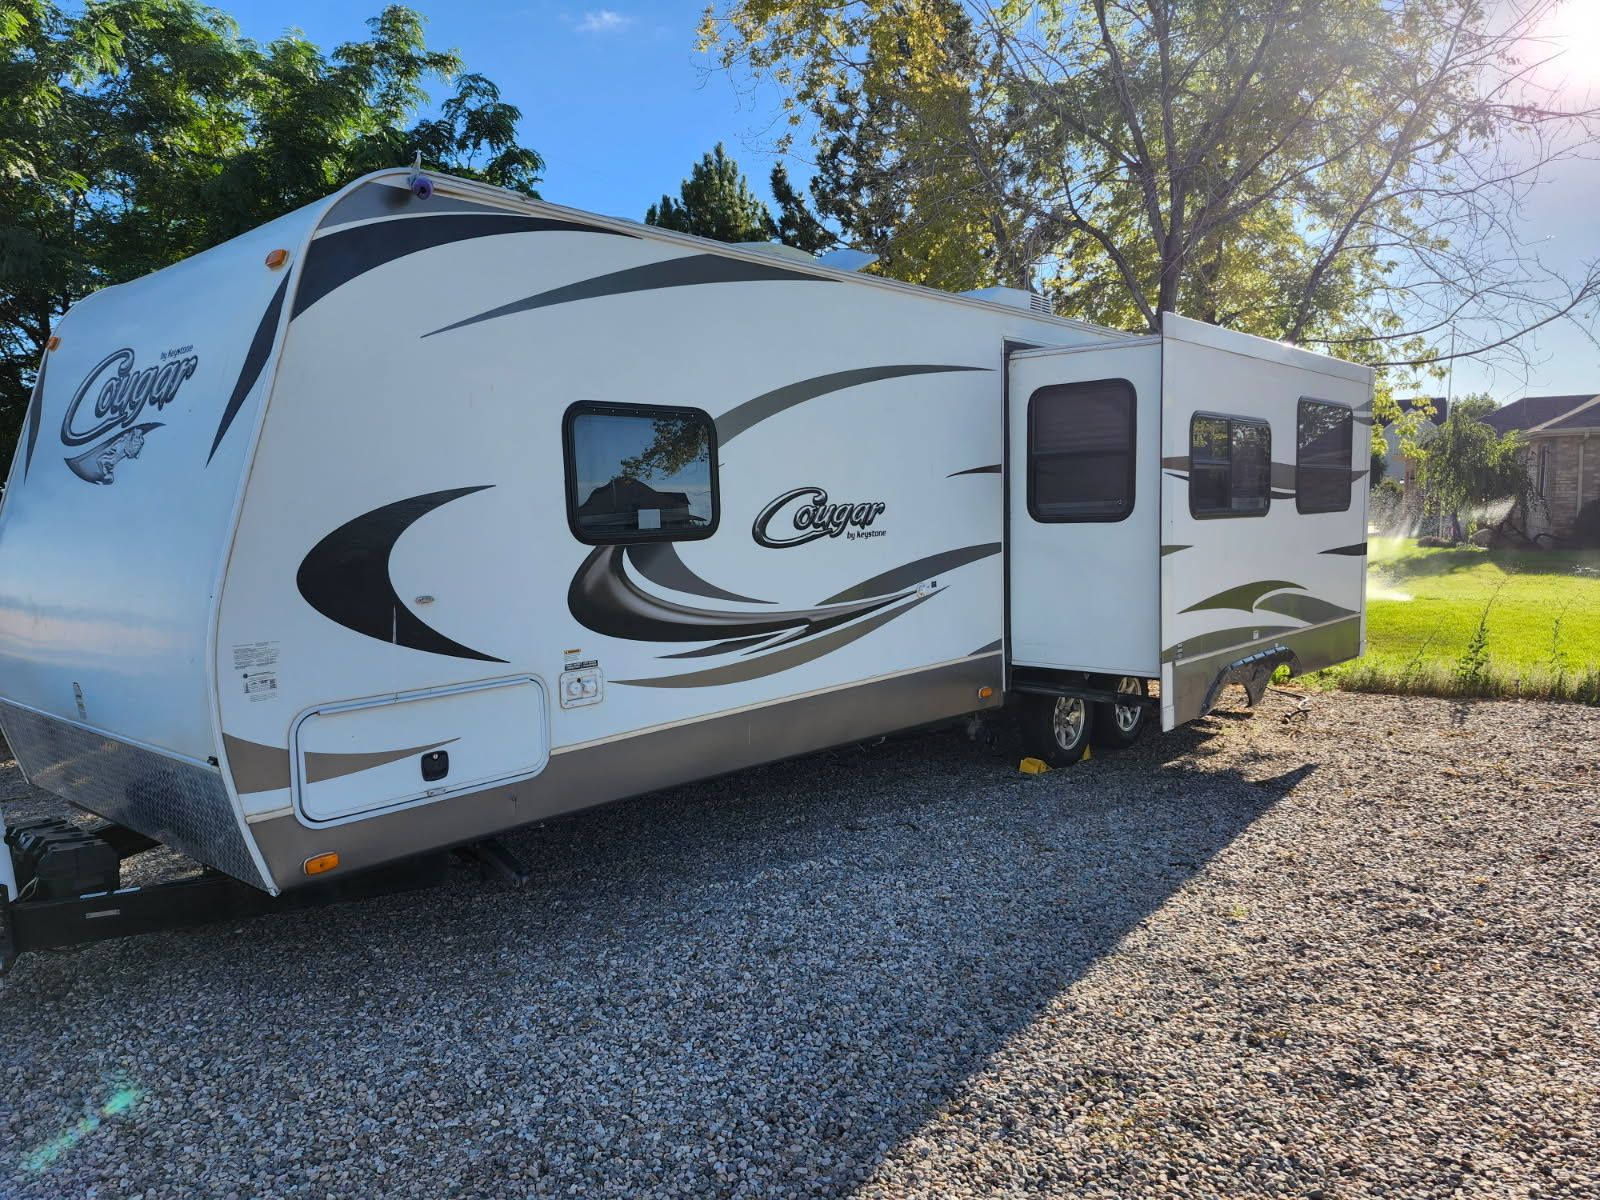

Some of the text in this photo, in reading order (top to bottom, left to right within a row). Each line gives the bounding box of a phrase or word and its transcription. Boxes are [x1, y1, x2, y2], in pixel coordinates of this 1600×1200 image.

[160, 345, 194, 361] by Keystone
[61, 347, 198, 447] Cougar
[752, 487, 886, 549] Cougar
[847, 530, 887, 540] by Keystone
